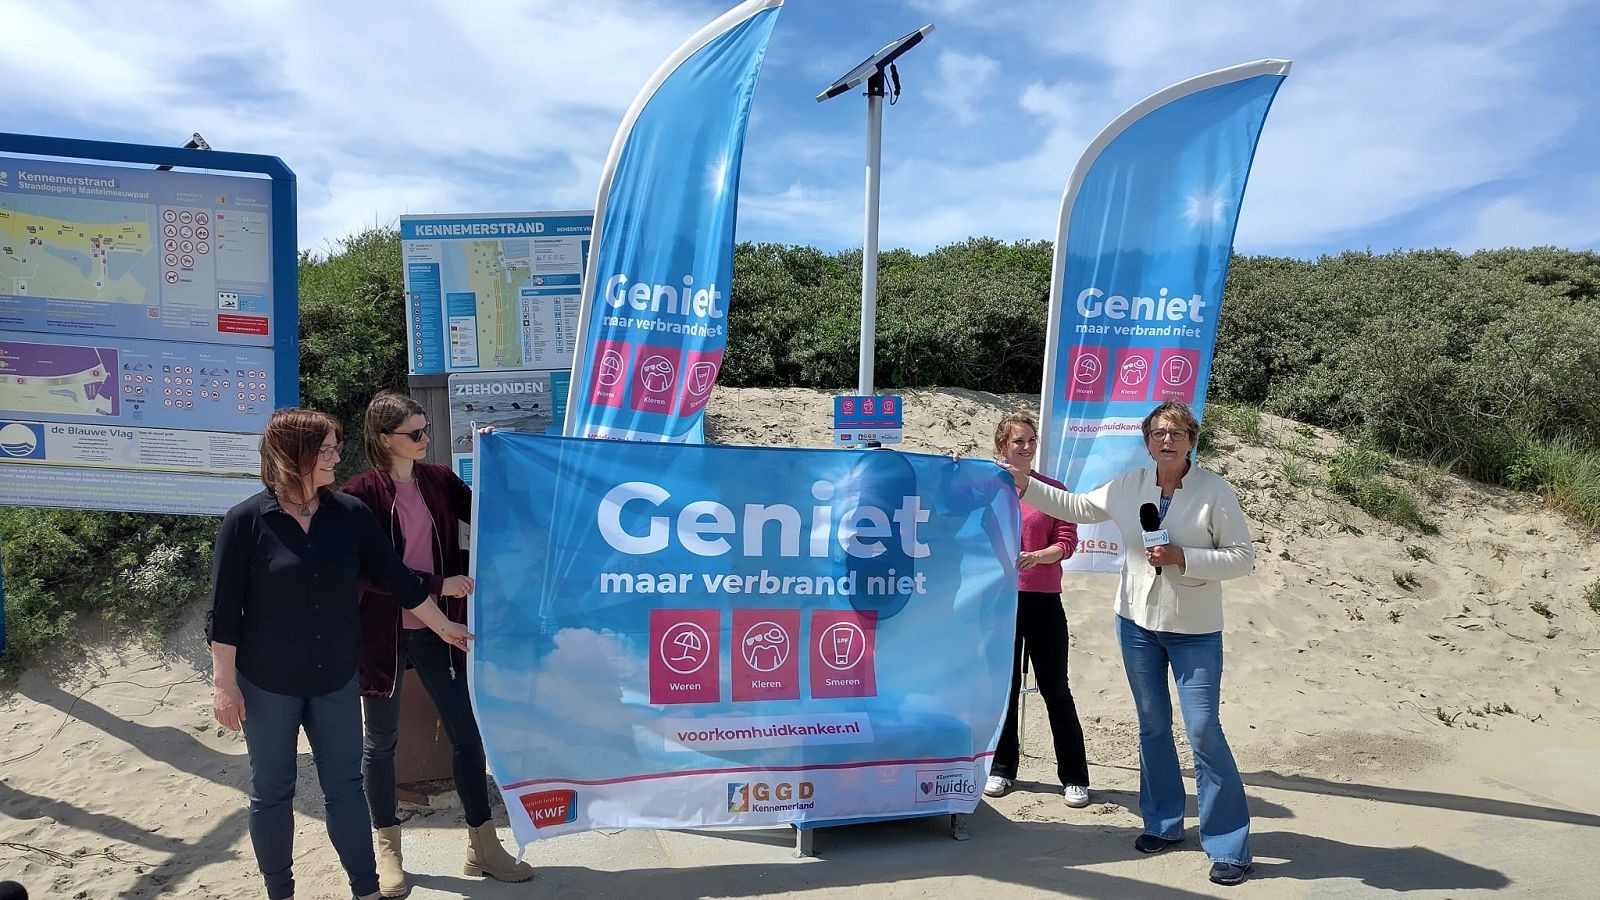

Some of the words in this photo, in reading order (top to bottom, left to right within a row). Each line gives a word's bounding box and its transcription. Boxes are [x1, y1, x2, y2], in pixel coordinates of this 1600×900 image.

[18, 171, 115, 188] Kennemerstrand
[18, 181, 77, 195] Strandopgang
[78, 186, 149, 200] Mantelmeeuwpad
[415, 222, 545, 236] KENNEMERSTRAND
[605, 273, 724, 319] Geniet
[1076, 287, 1206, 323] Geniet
[636, 317, 697, 336] verbrand
[1075, 324, 1110, 335] maar
[1114, 325, 1172, 337] verbrand
[1173, 325, 1201, 338] niet
[455, 382, 544, 396] ZEEHONDEN
[1161, 389, 1185, 397] Smeren
[643, 396, 666, 405] Kleren
[51, 426, 65, 434] de
[68, 426, 107, 437] Blauwe
[109, 429, 133, 440] Vlag
[597, 480, 931, 559] Geniet
[600, 570, 693, 595] maar
[702, 569, 857, 596] verbrand
[867, 568, 927, 596] niet
[669, 682, 701, 691] Weren
[751, 679, 782, 689] Kleren
[825, 677, 860, 687] Smeren
[677, 721, 860, 743] voorkomhuidkanker.nl
[752, 781, 815, 801] GGD
[535, 805, 566, 821] KWF
[752, 801, 815, 813] Kennemerland
